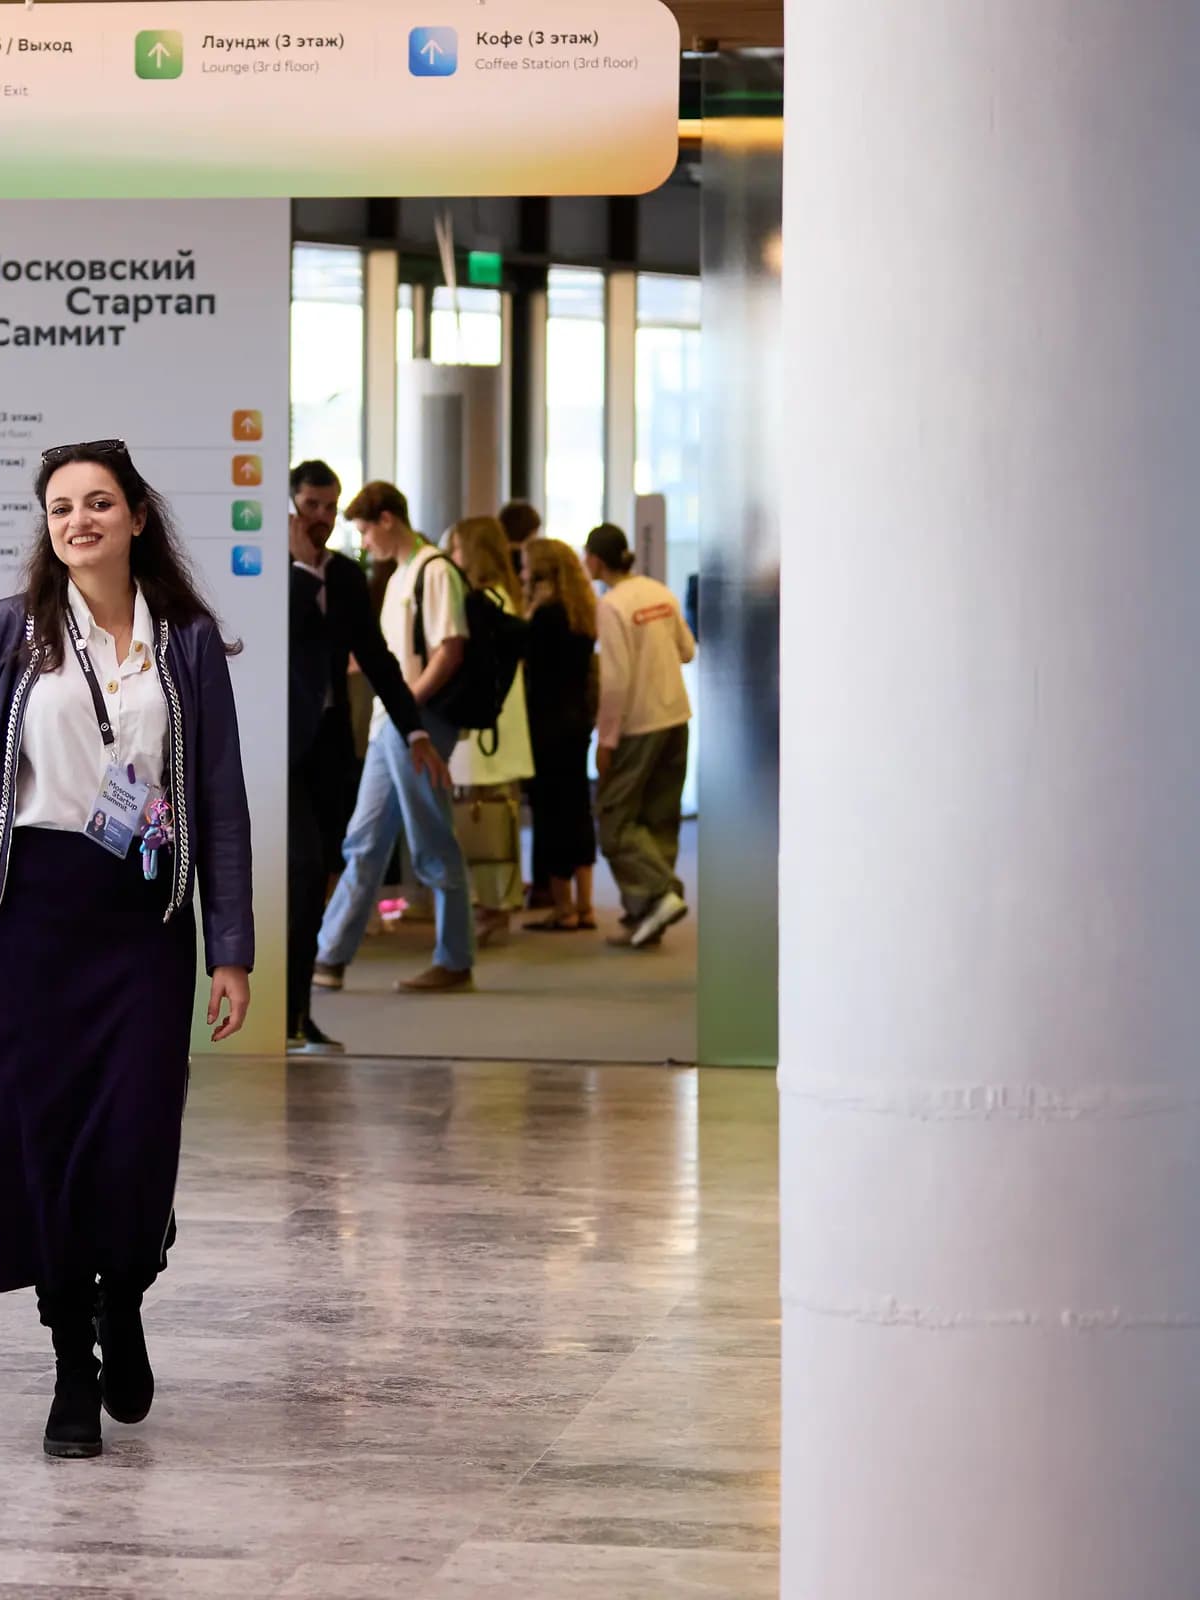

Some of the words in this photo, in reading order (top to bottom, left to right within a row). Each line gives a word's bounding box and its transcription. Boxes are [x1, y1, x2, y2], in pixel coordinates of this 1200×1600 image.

[6, 37, 13, 55] /
[17, 38, 73, 54] Выход
[202, 34, 270, 52] Лаундж
[275, 34, 291, 51] (3
[297, 33, 345, 50] этаж)
[476, 30, 523, 48] Кофе
[528, 30, 544, 47] (3
[550, 30, 599, 47] этаж)
[201, 61, 249, 75] Lounge
[284, 60, 320, 74] floor)
[475, 57, 518, 70] Coffee
[522, 57, 569, 70] Station
[573, 56, 600, 71] (3rd
[603, 56, 638, 70] floor)
[4, 85, 29, 97] Exit
[65, 286, 216, 323] Стартап
[109, 780, 136, 801] Moscow
[102, 790, 128, 812] Summit
[112, 790, 138, 811] Startup
